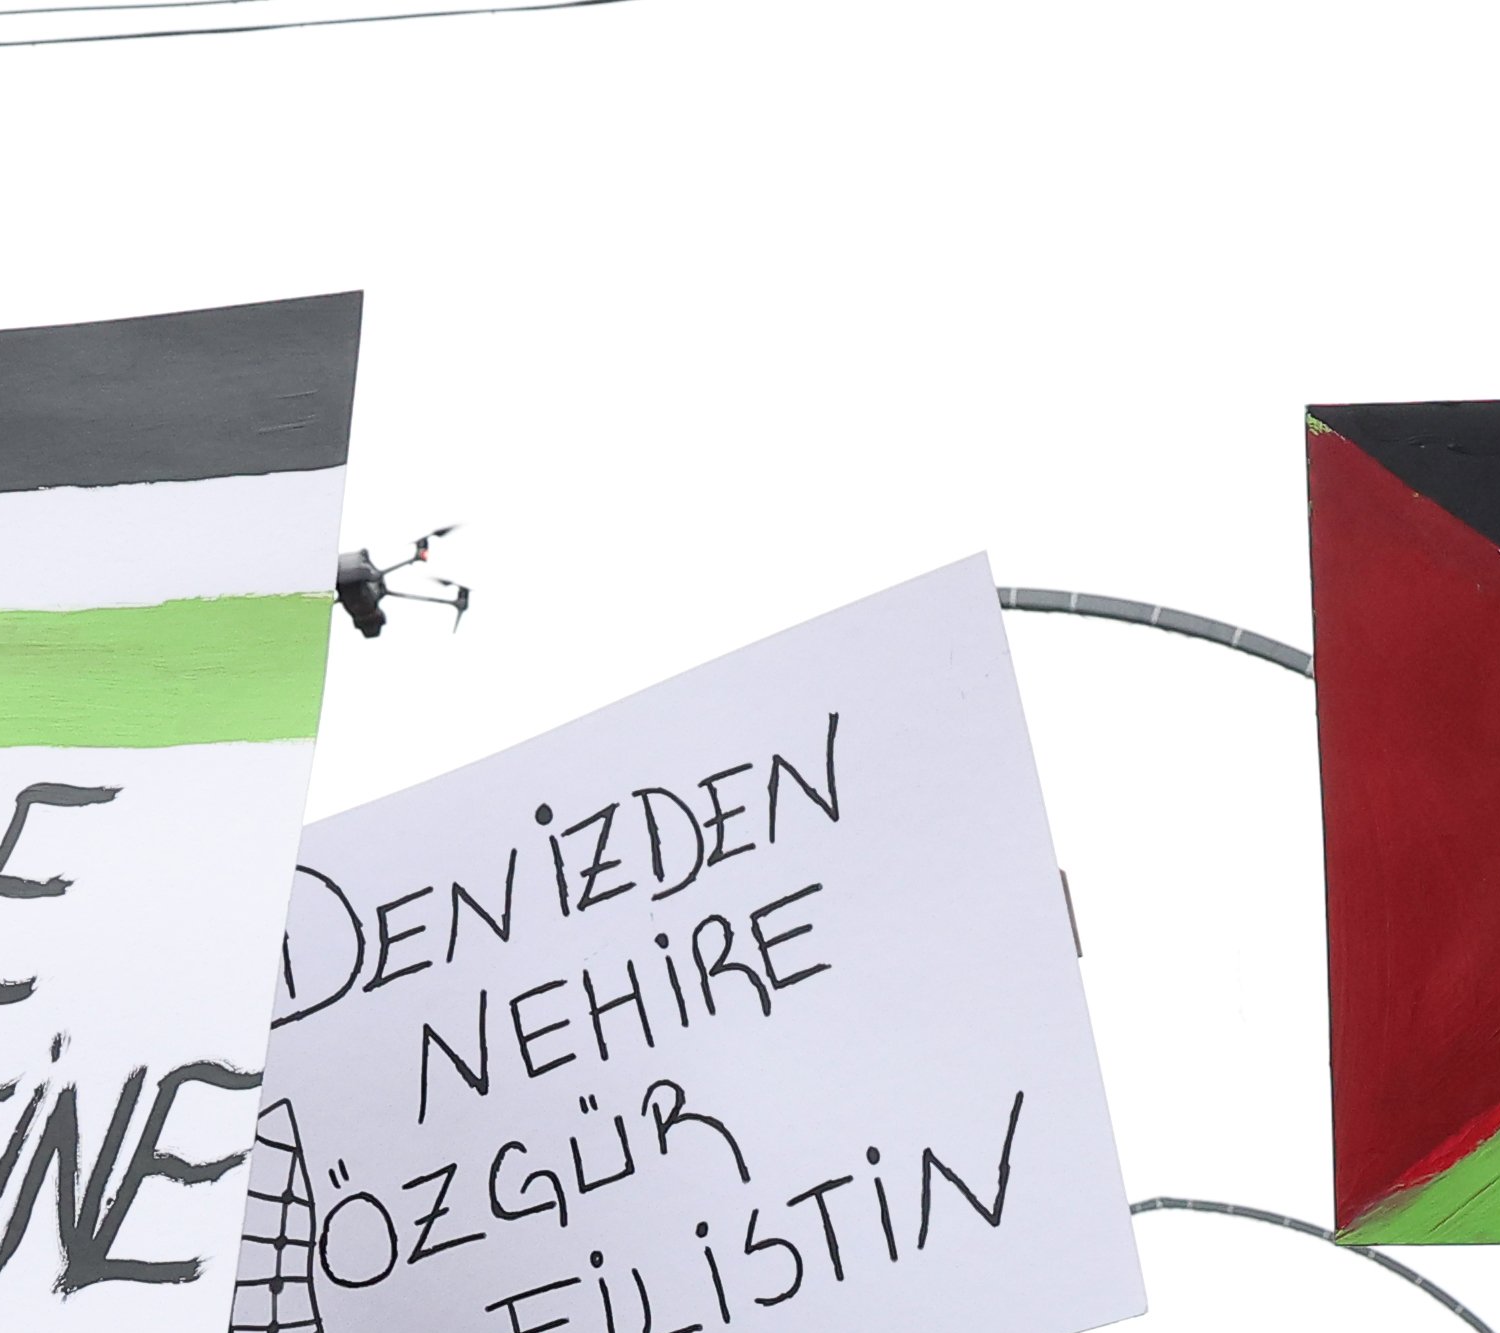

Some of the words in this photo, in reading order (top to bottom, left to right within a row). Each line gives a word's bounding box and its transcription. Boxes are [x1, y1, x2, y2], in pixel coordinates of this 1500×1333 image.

[271, 712, 839, 1030] DENİZDEN
[418, 884, 831, 1123] NEHİRE
[319, 1079, 750, 1288] ÖZGÜR
